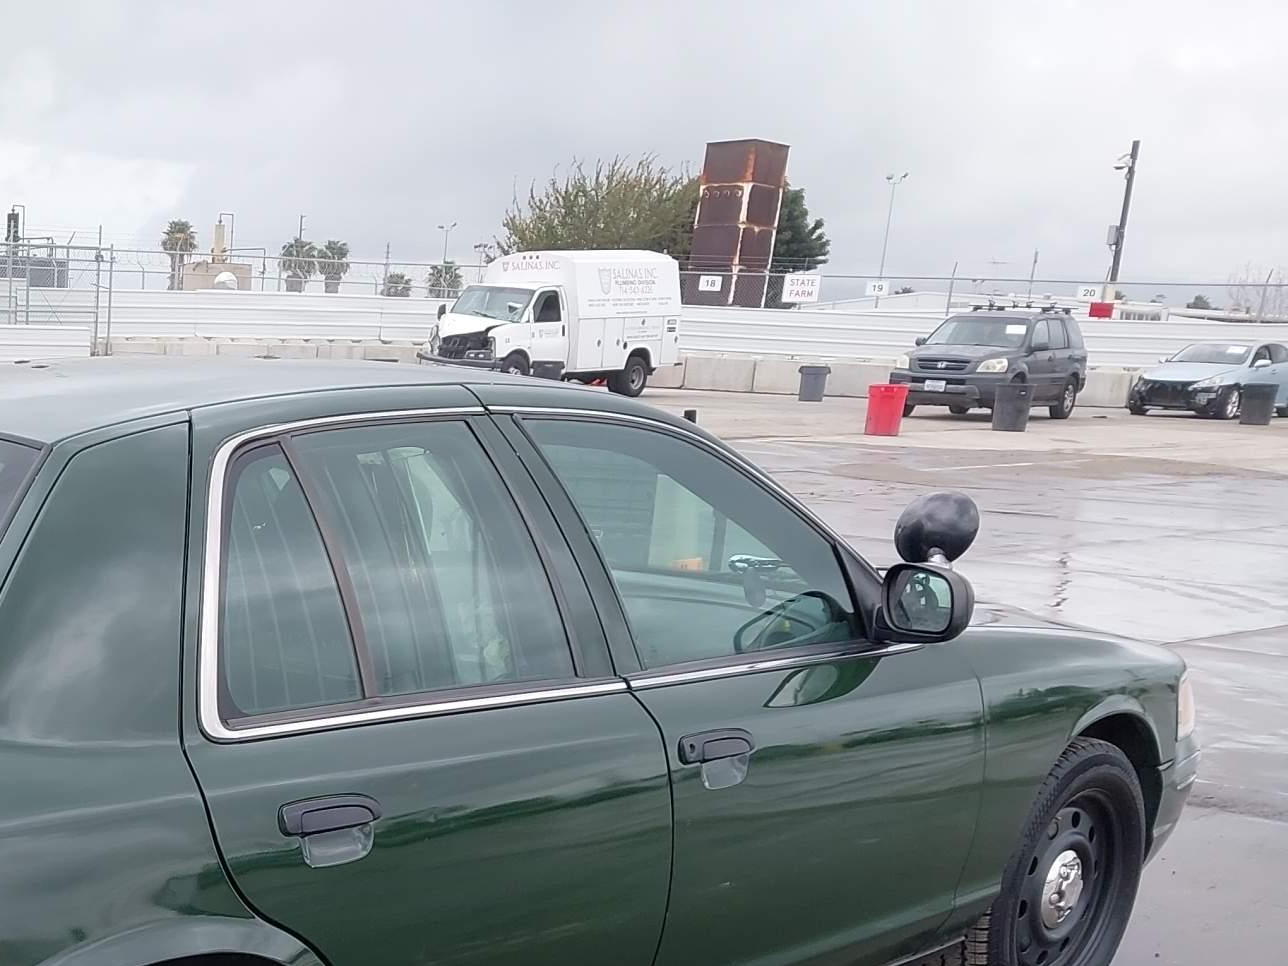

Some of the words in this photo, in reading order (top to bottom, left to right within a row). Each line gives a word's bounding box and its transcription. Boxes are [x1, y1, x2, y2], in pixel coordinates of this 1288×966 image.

[705, 279, 716, 288] 18
[790, 279, 816, 288] STATE
[872, 284, 884, 293] 19
[1083, 288, 1096, 297] 20
[789, 289, 813, 298] FARM
